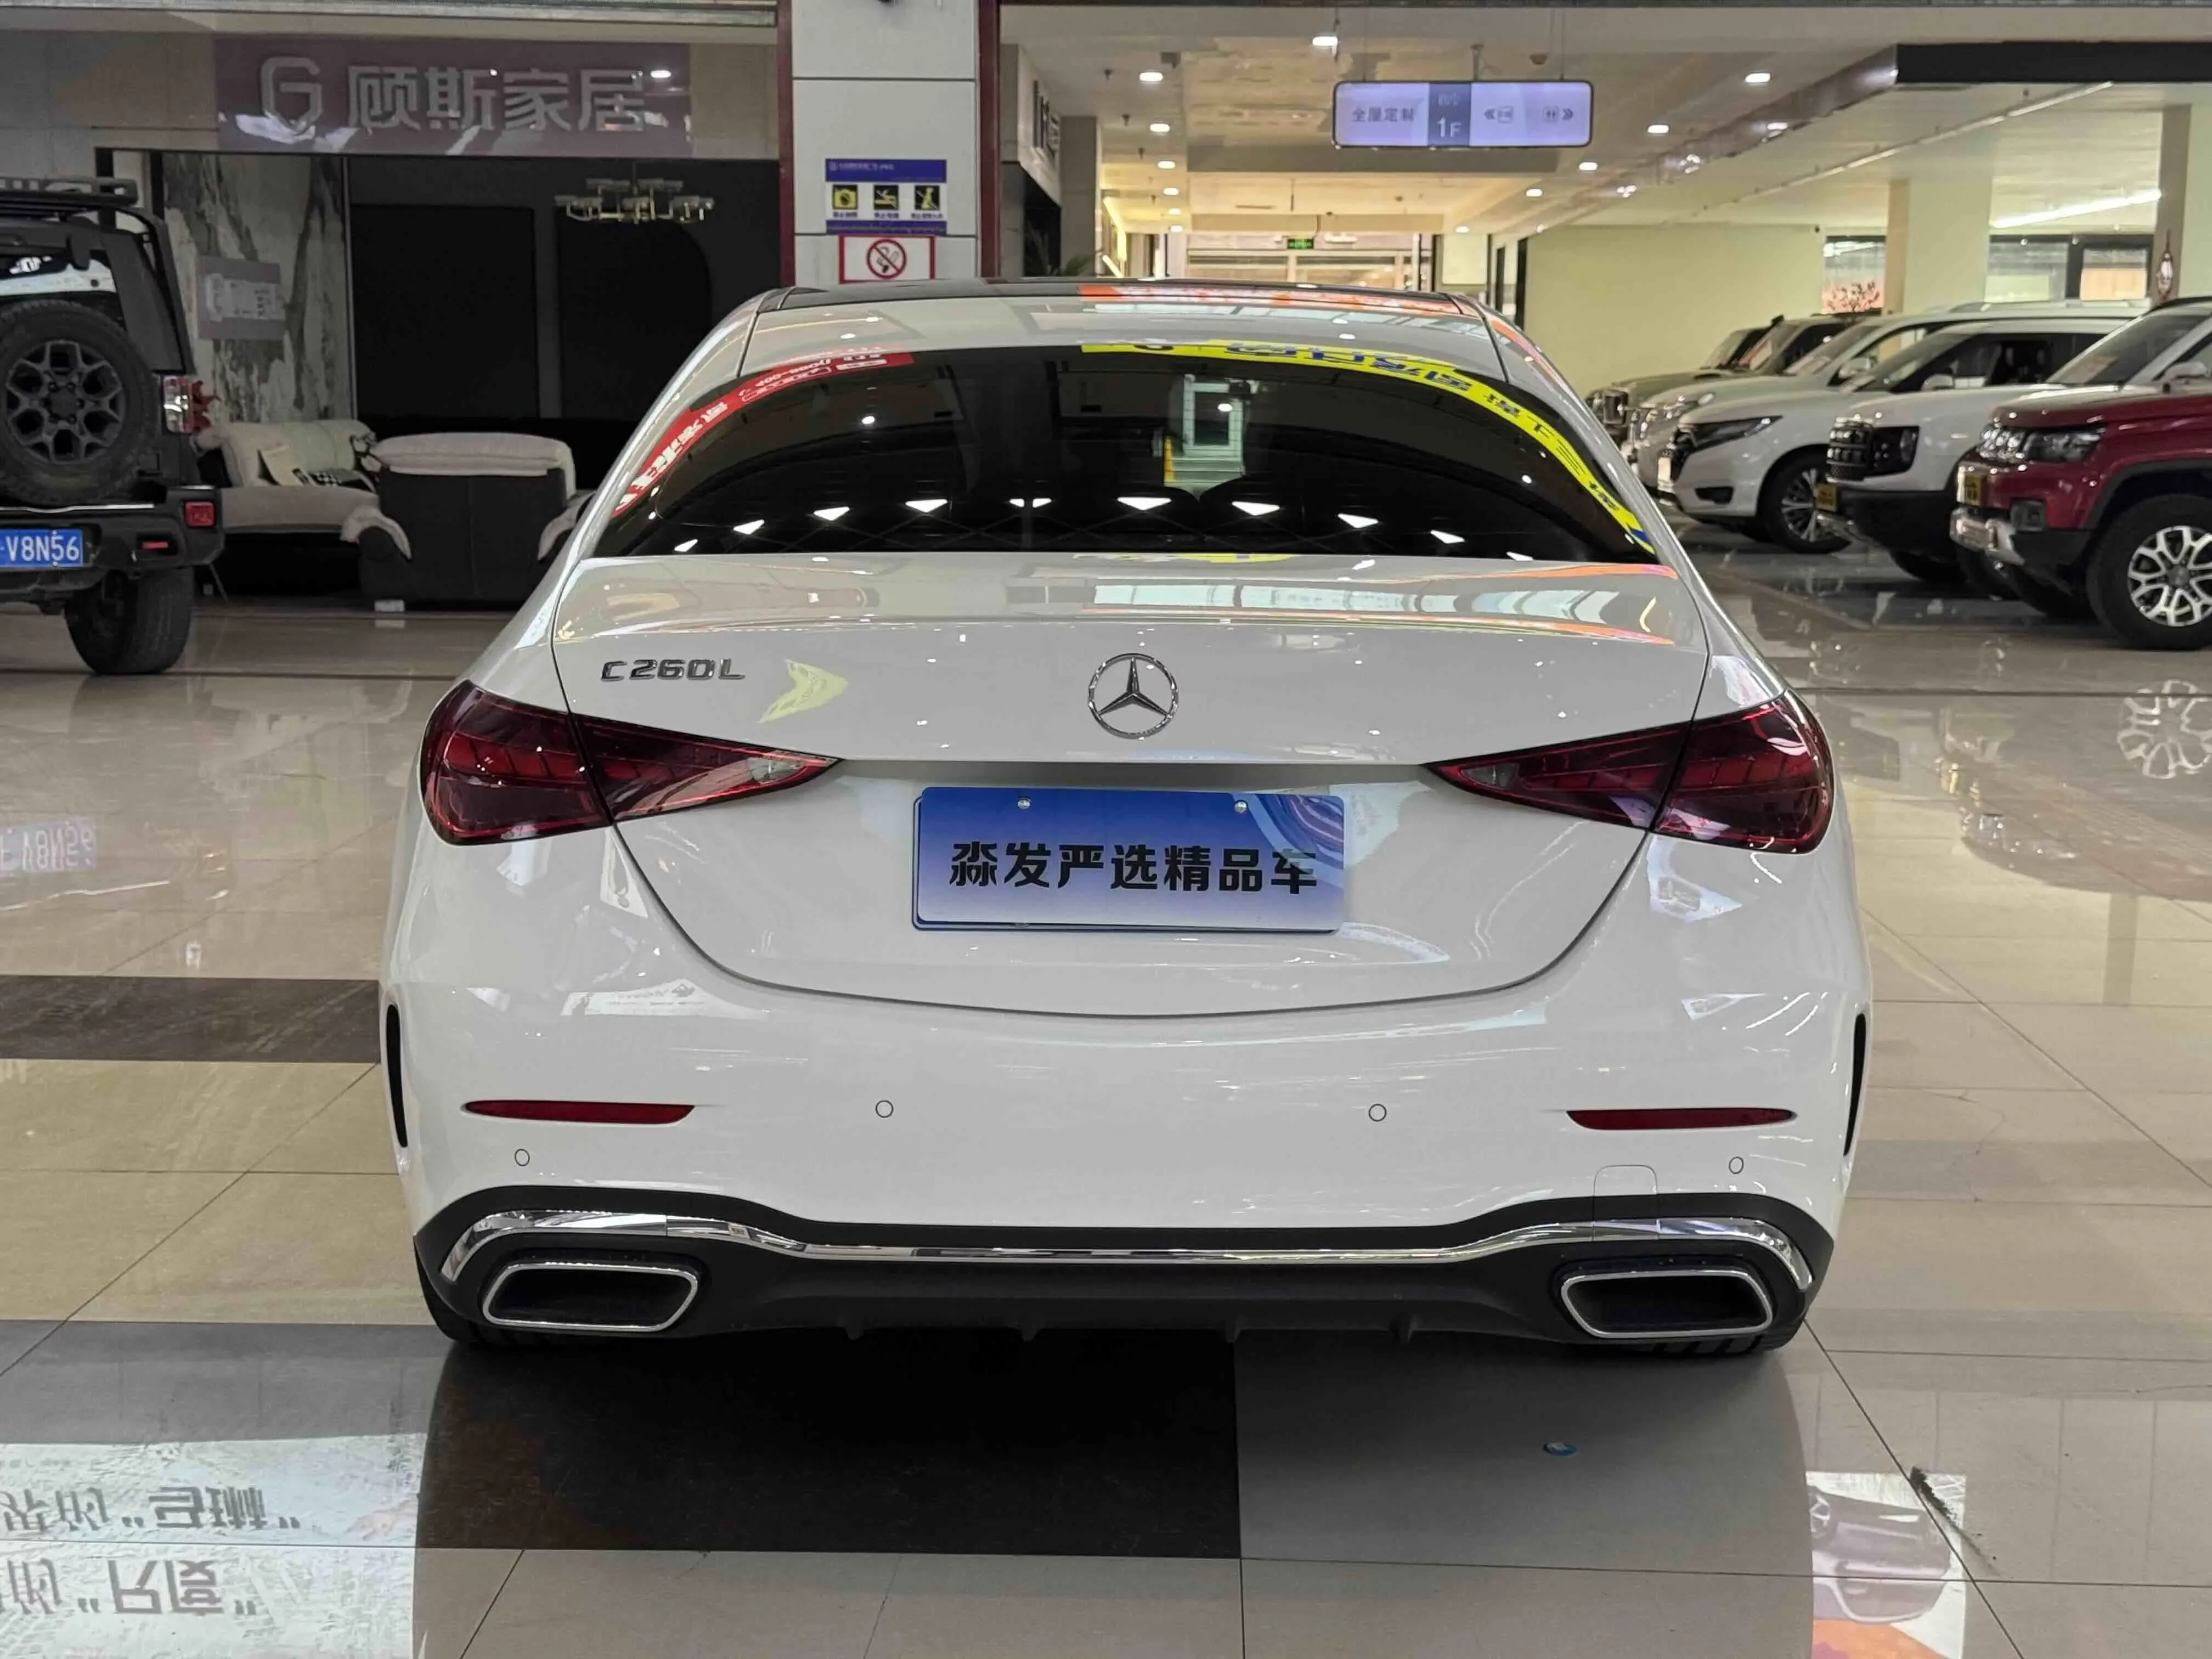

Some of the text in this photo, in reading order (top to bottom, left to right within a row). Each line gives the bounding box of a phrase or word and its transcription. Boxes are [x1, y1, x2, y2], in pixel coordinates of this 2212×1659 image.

[347, 65, 645, 132] 顾斯家居
[1436, 115, 1462, 138] 1F
[949, 840, 1317, 895] 淼发严选精品车
